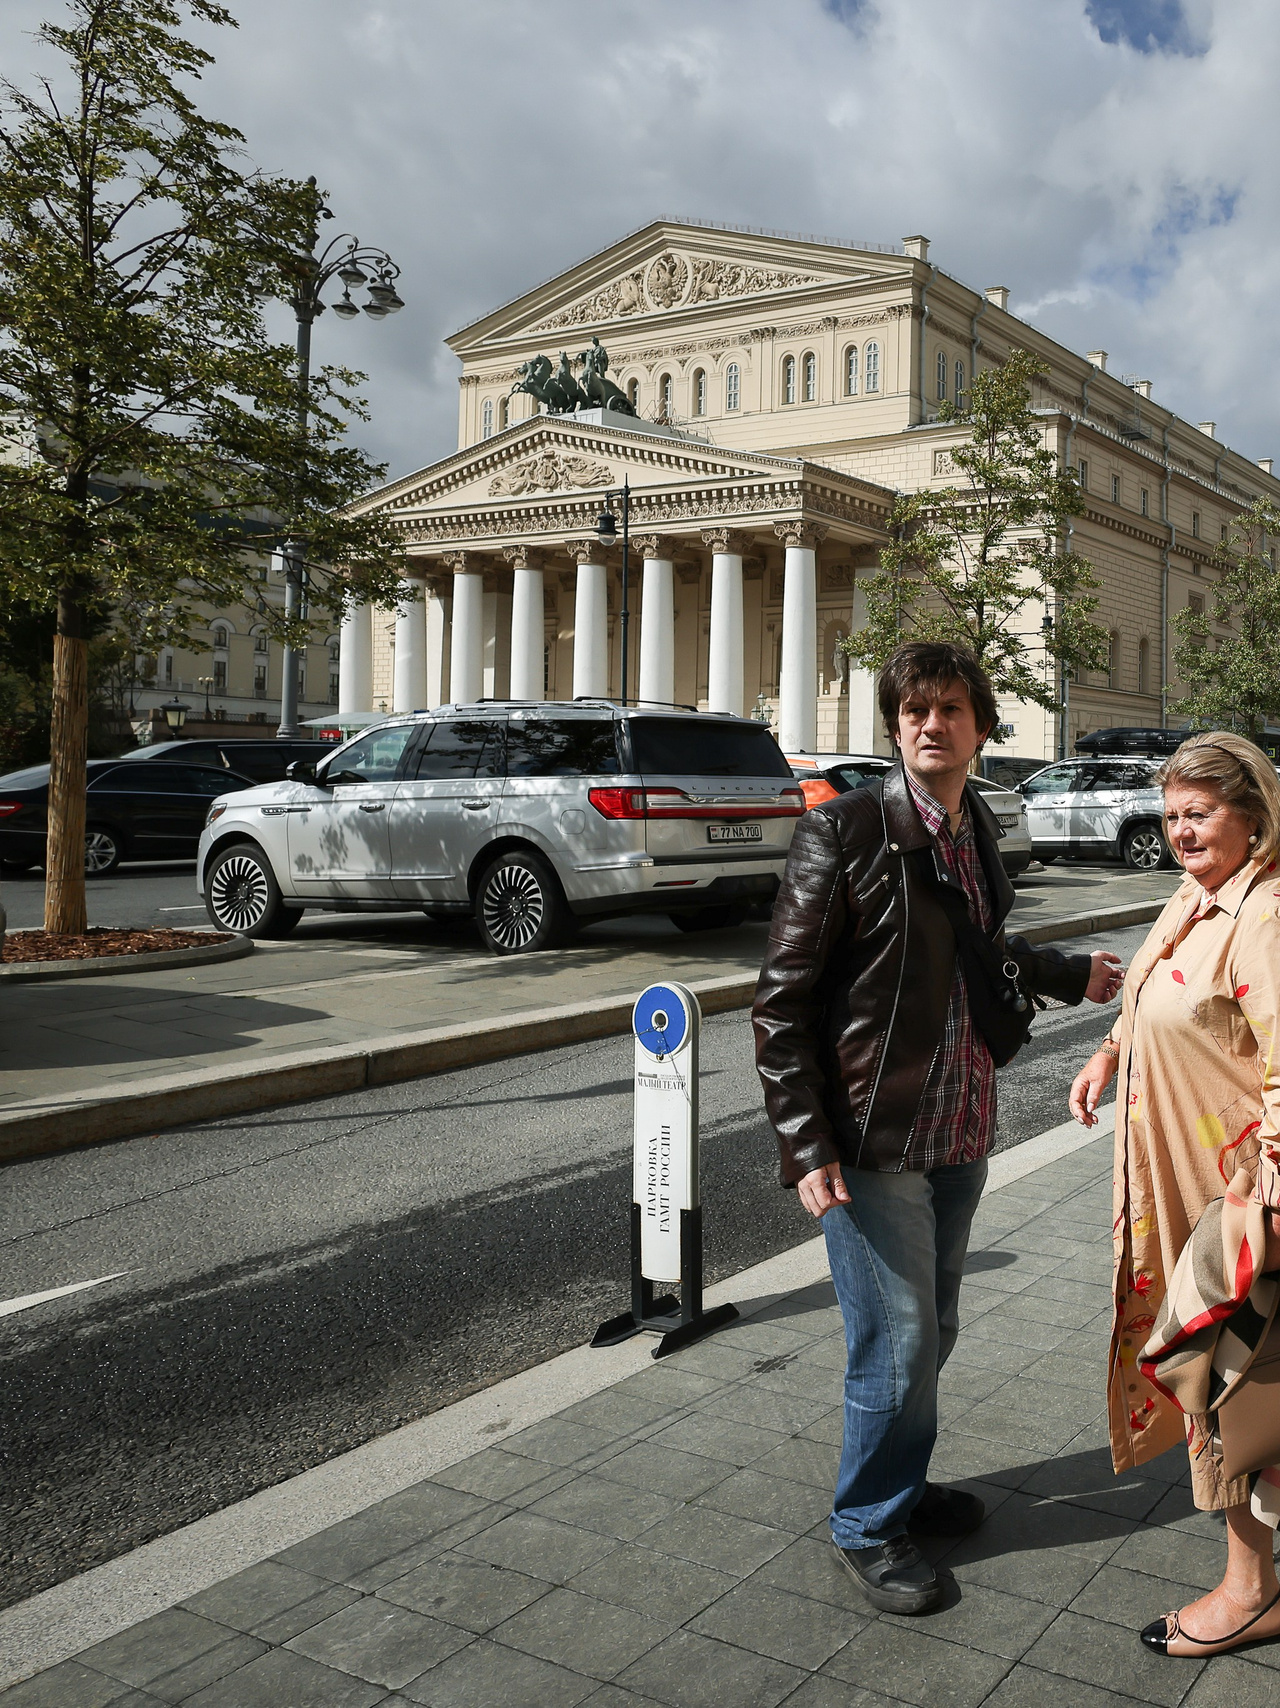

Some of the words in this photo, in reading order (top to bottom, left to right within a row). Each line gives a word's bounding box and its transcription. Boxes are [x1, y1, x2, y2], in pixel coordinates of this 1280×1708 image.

[720, 827, 730, 838] 77
[732, 827, 744, 838] NA
[745, 826, 759, 838] 700
[647, 1137, 658, 1217] ПАРКОВКА
[660, 1125, 671, 1187] РОССИИ
[660, 1194, 670, 1232] ГАМТ
